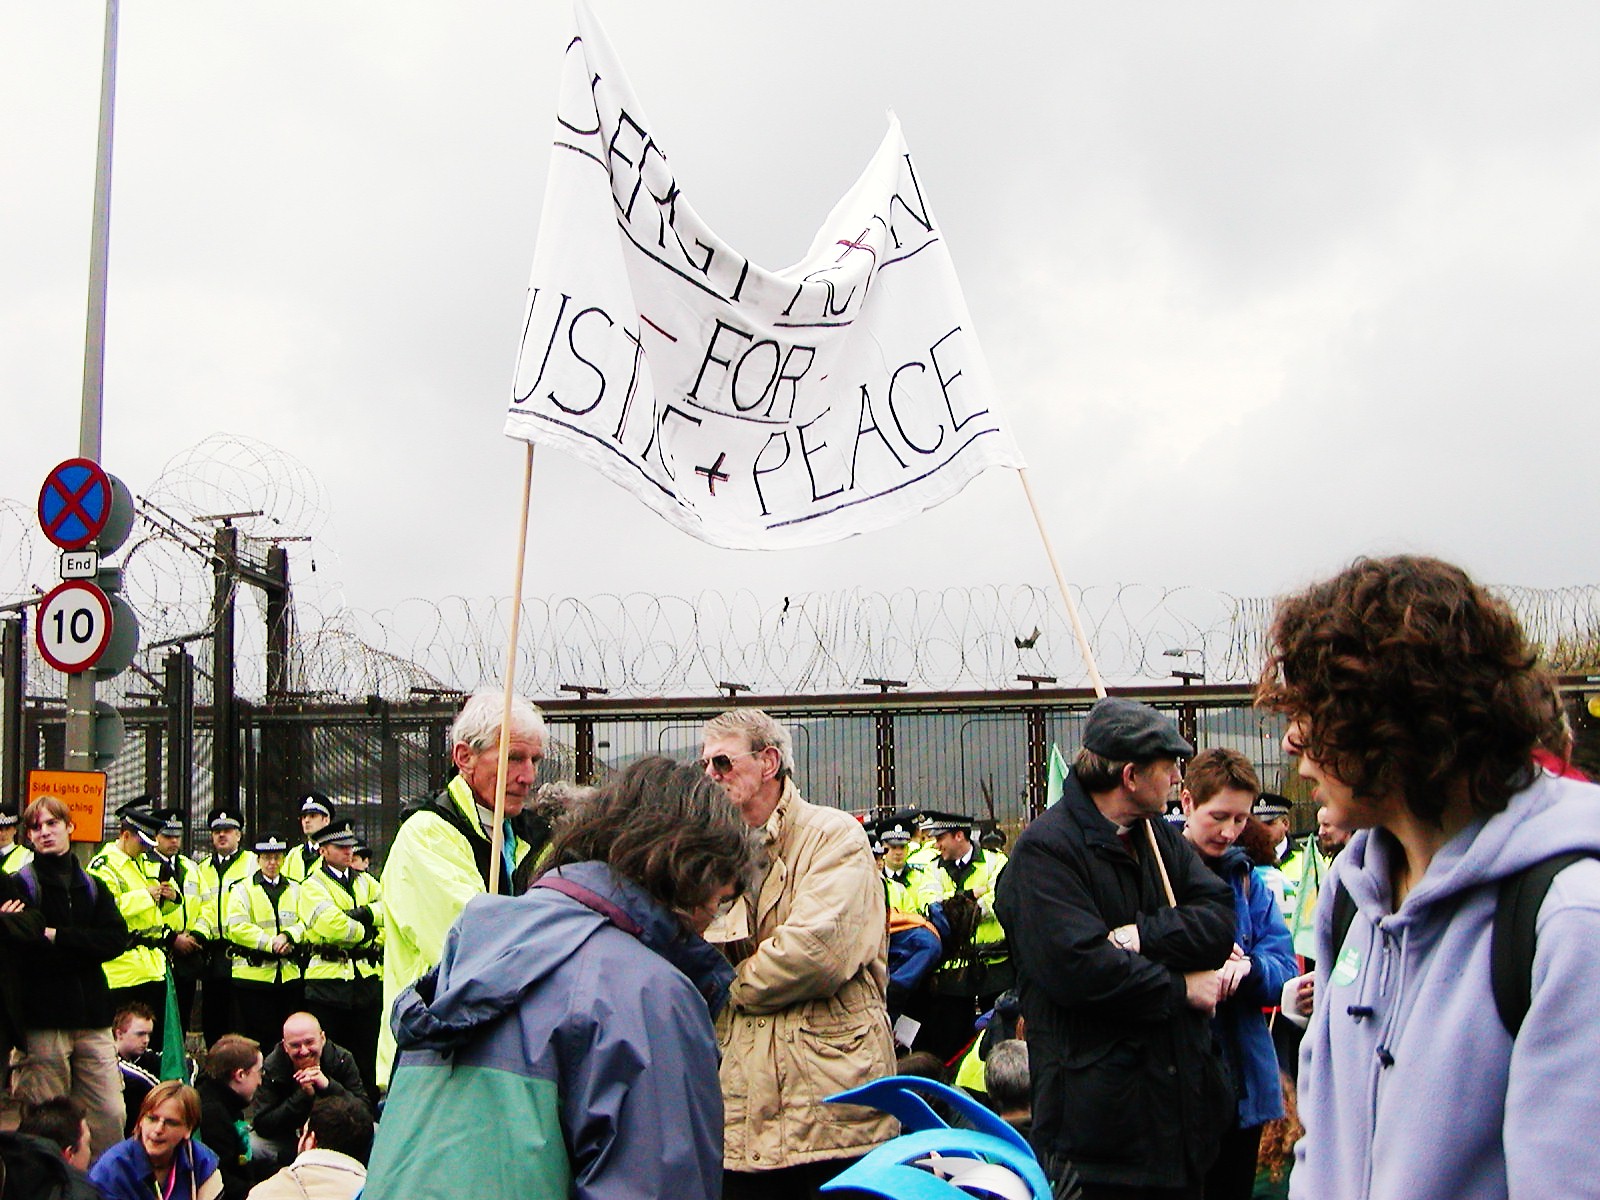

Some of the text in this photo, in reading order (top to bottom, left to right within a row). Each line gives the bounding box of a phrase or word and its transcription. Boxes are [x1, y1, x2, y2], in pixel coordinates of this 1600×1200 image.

[687, 317, 817, 419] FOR
[752, 326, 990, 517] PEACE
[67, 558, 92, 570] End
[53, 608, 94, 644] 10
[32, 782, 103, 797] Side Lights Only
[67, 803, 94, 815] ching
